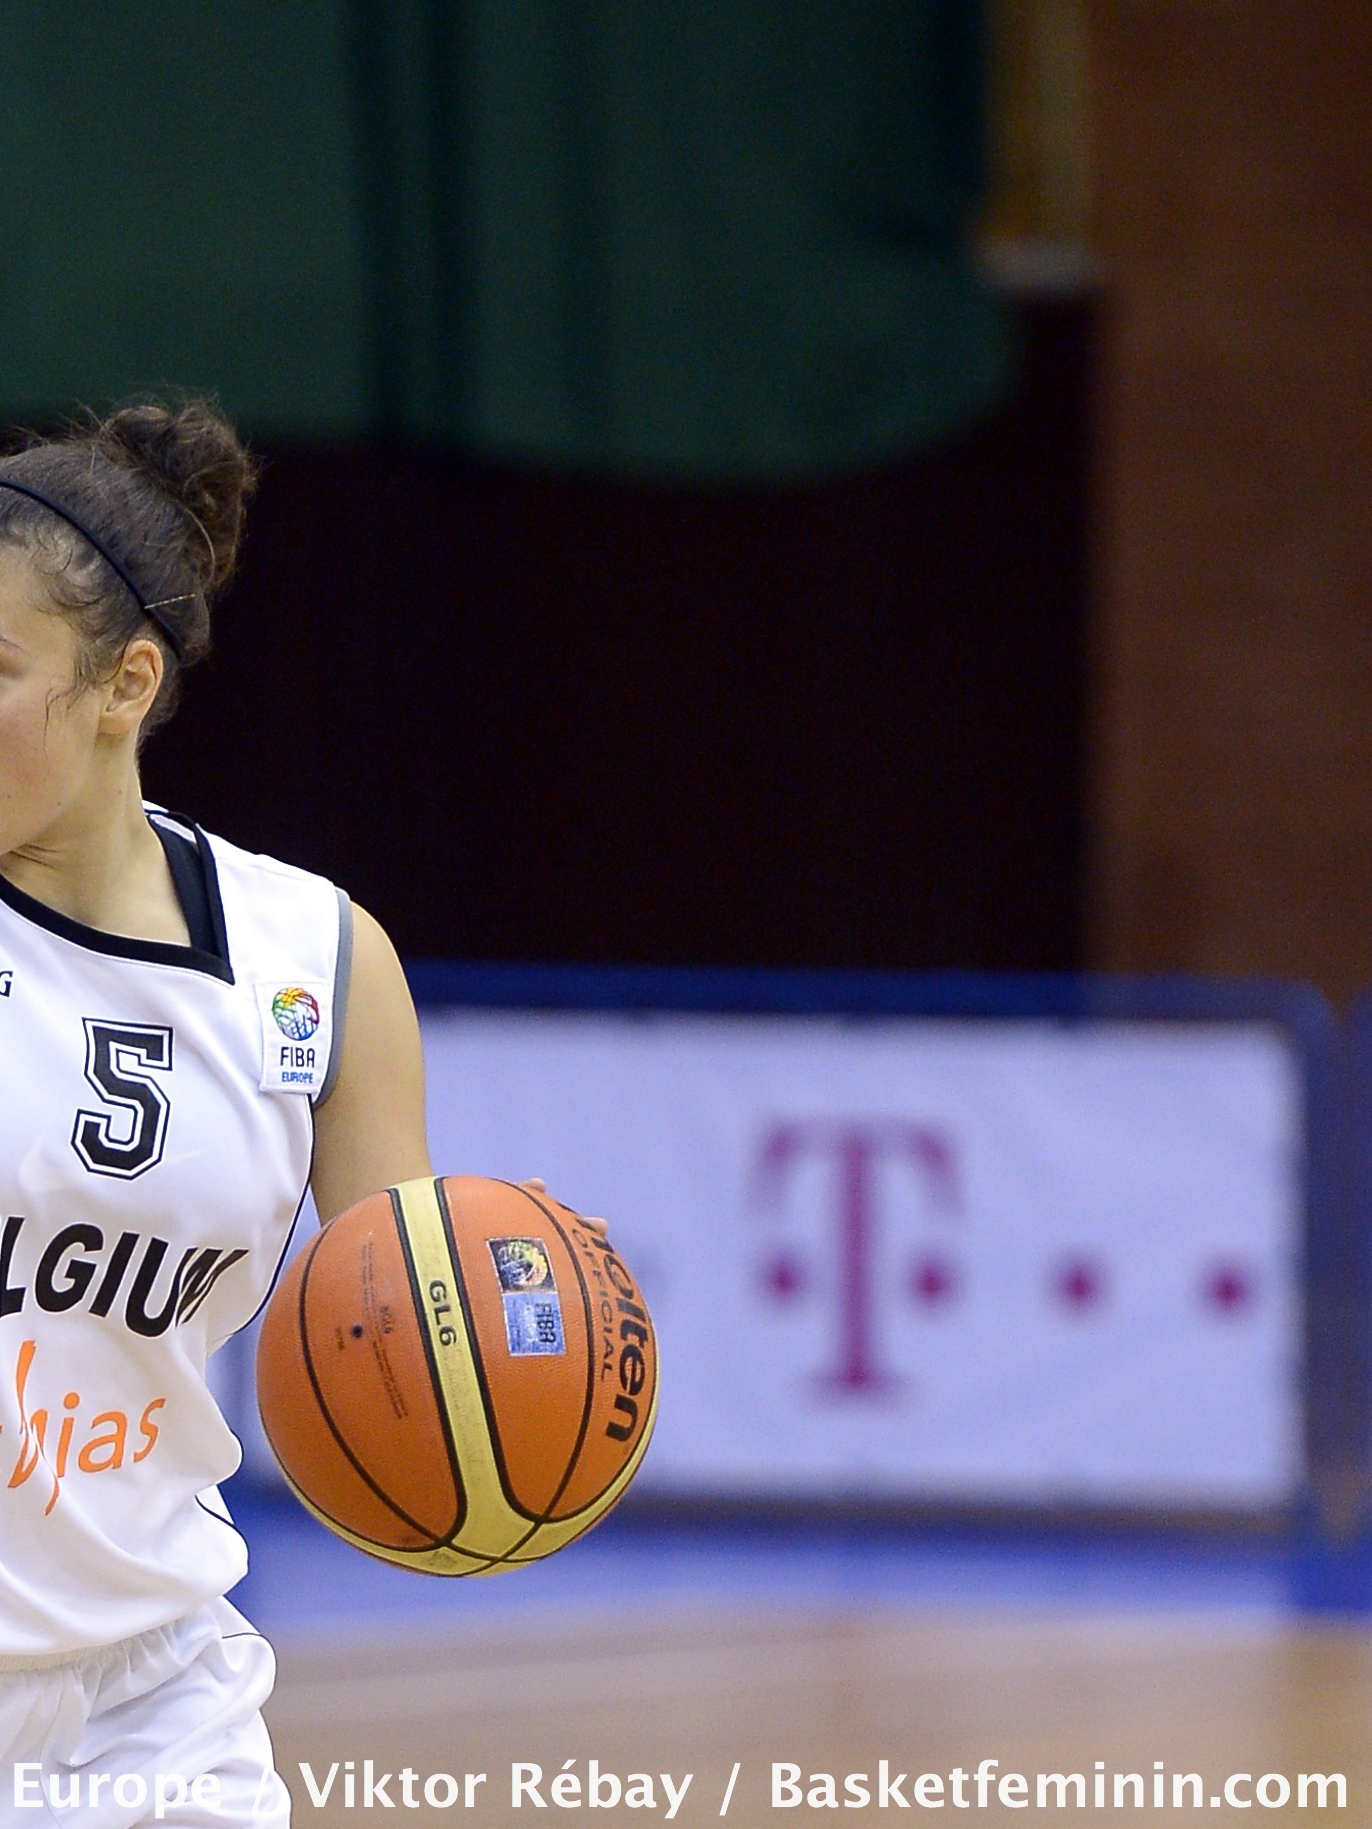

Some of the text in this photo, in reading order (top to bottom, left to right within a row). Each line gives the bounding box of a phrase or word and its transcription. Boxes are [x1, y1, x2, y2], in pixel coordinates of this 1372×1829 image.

[279, 1046, 316, 1069] FIBA
[280, 1071, 315, 1084] EUROPE
[70, 1016, 174, 1181] 5
[428, 1279, 458, 1347] GL6
[534, 1302, 557, 1344] FIBA
[572, 1228, 615, 1381] OFFICIAL
